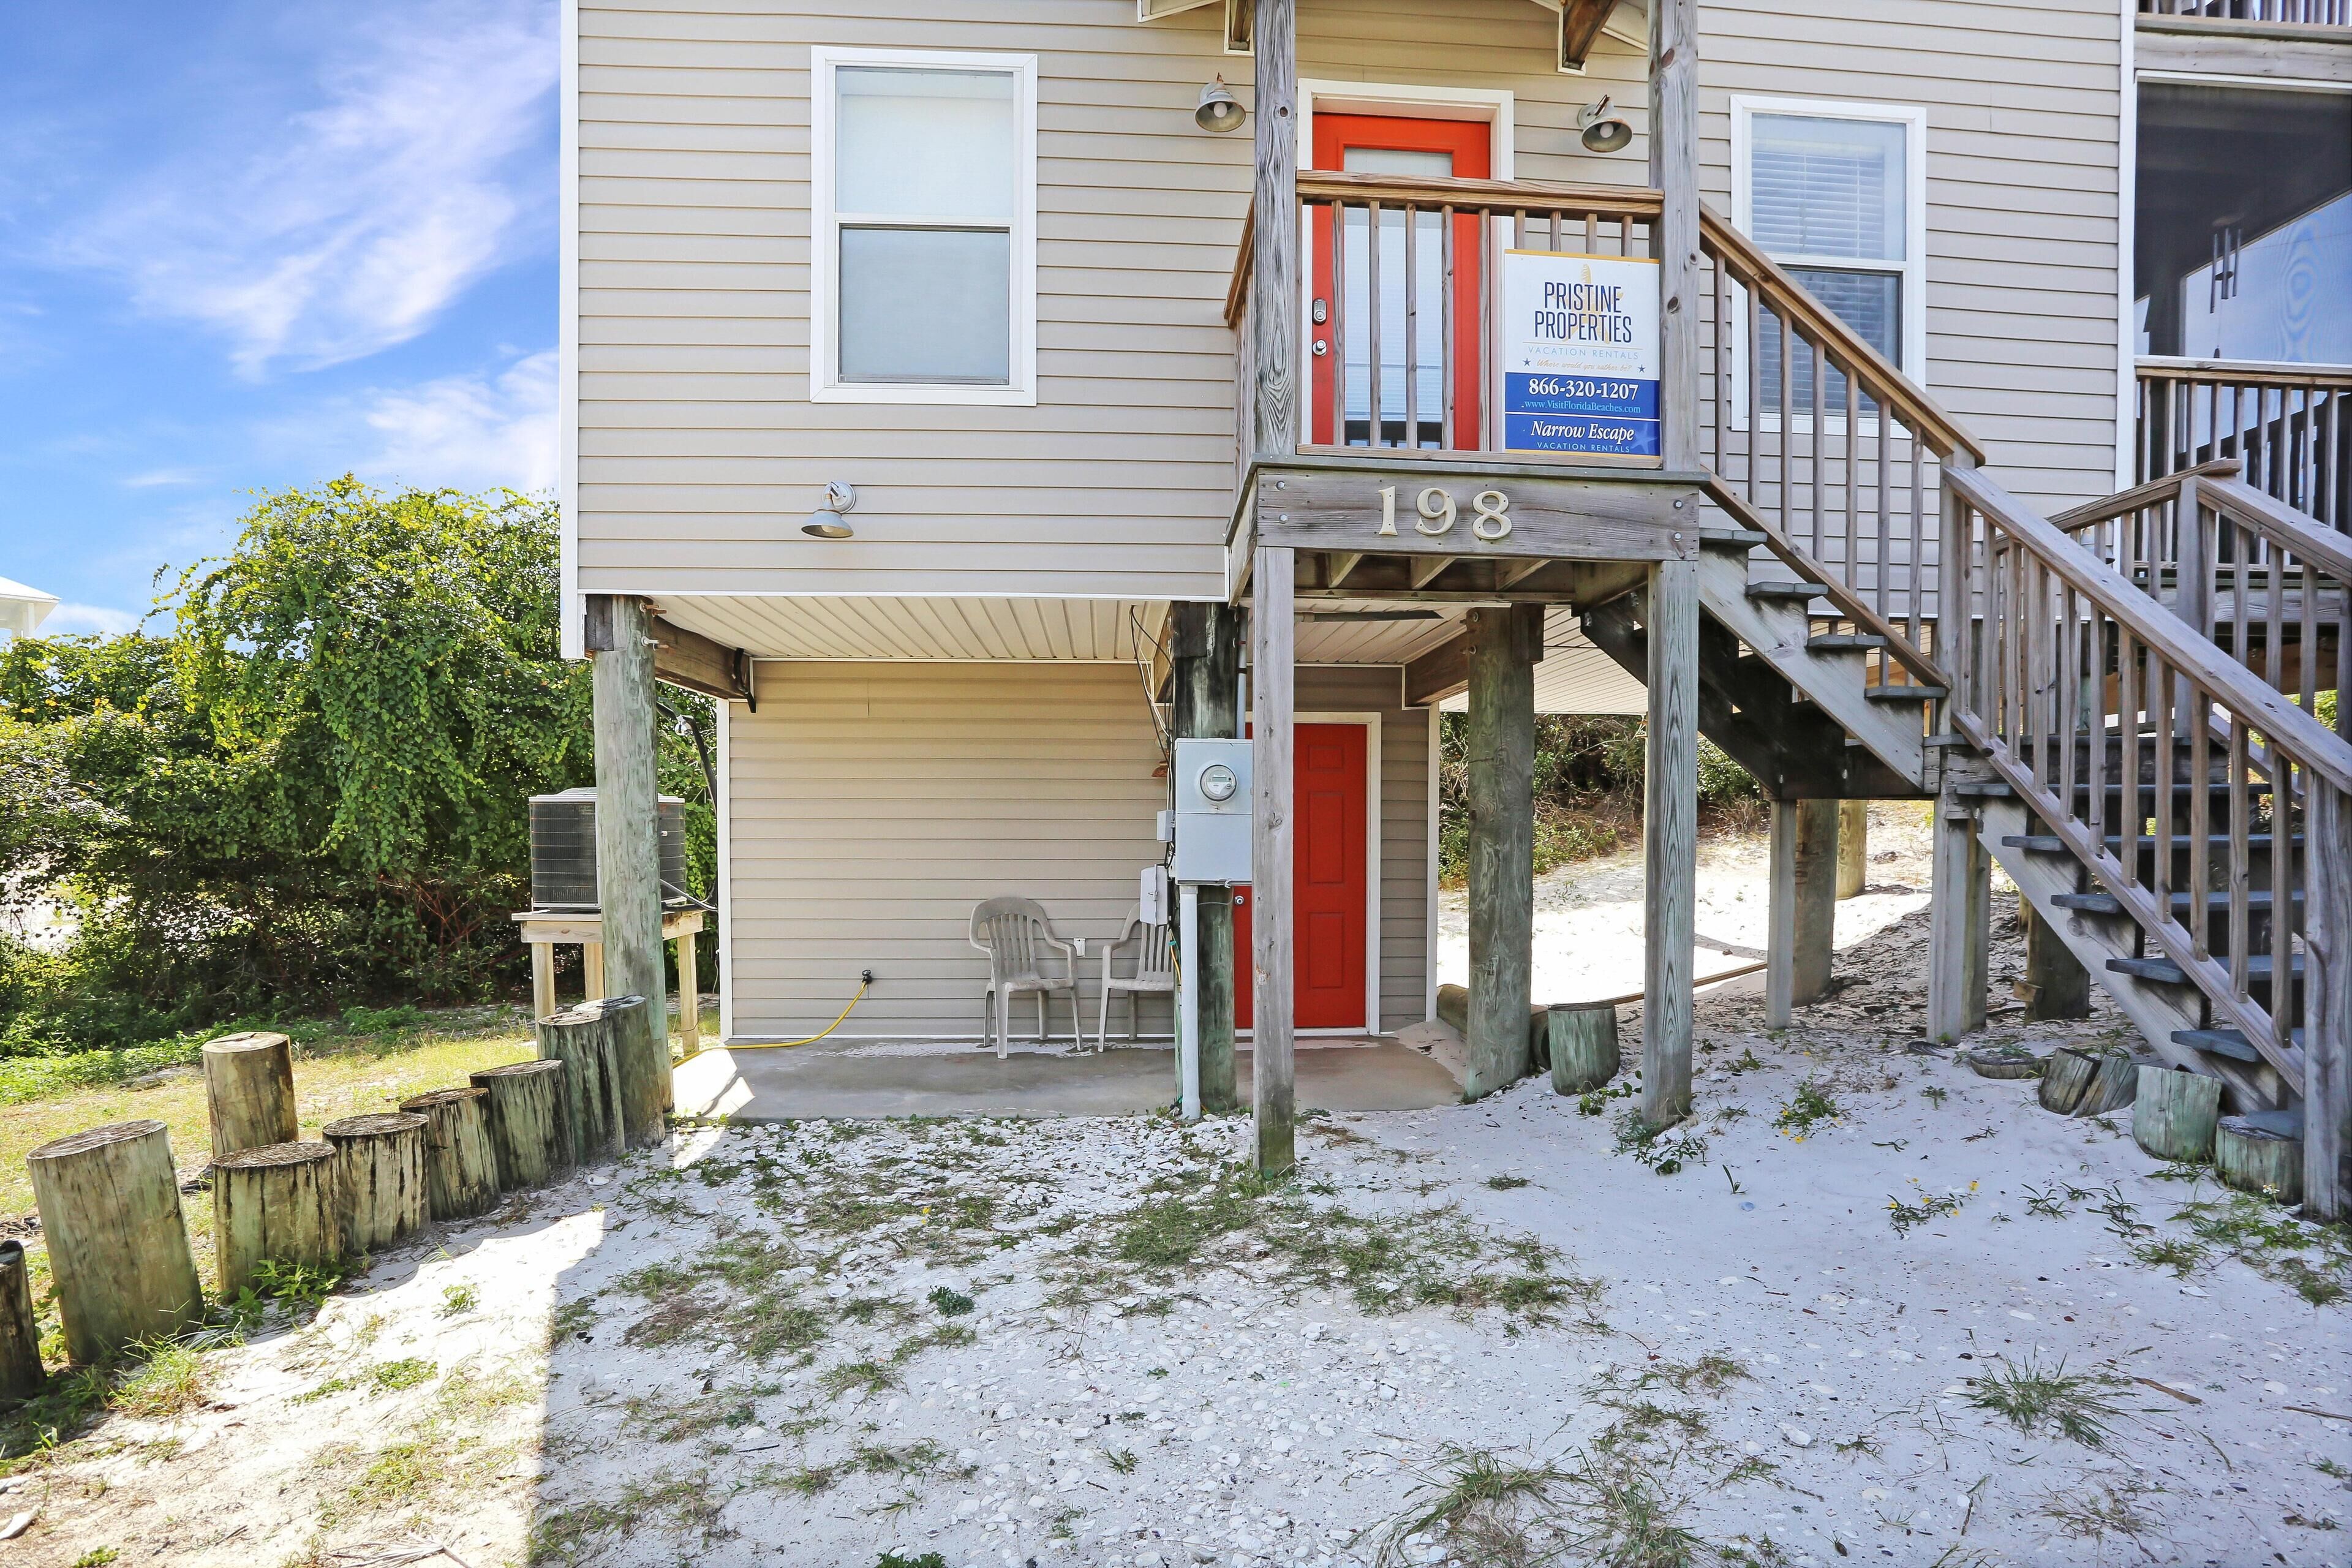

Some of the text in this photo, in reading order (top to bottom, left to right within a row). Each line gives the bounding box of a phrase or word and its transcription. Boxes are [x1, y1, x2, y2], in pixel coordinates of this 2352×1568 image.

[1545, 282, 1621, 313] PRISTINE
[1535, 311, 1632, 343] PROPERTIES
[1528, 346, 1639, 360] VACATION RENTALS
[1537, 359, 1559, 368] Where
[1529, 377, 1639, 401] 866-320-1207
[1525, 400, 1641, 413] www.VisitFloridaBeaches.com
[1531, 421, 1634, 445] Narrow Escape
[1591, 444, 1630, 453] RENTALS
[1378, 486, 1512, 540] 198
